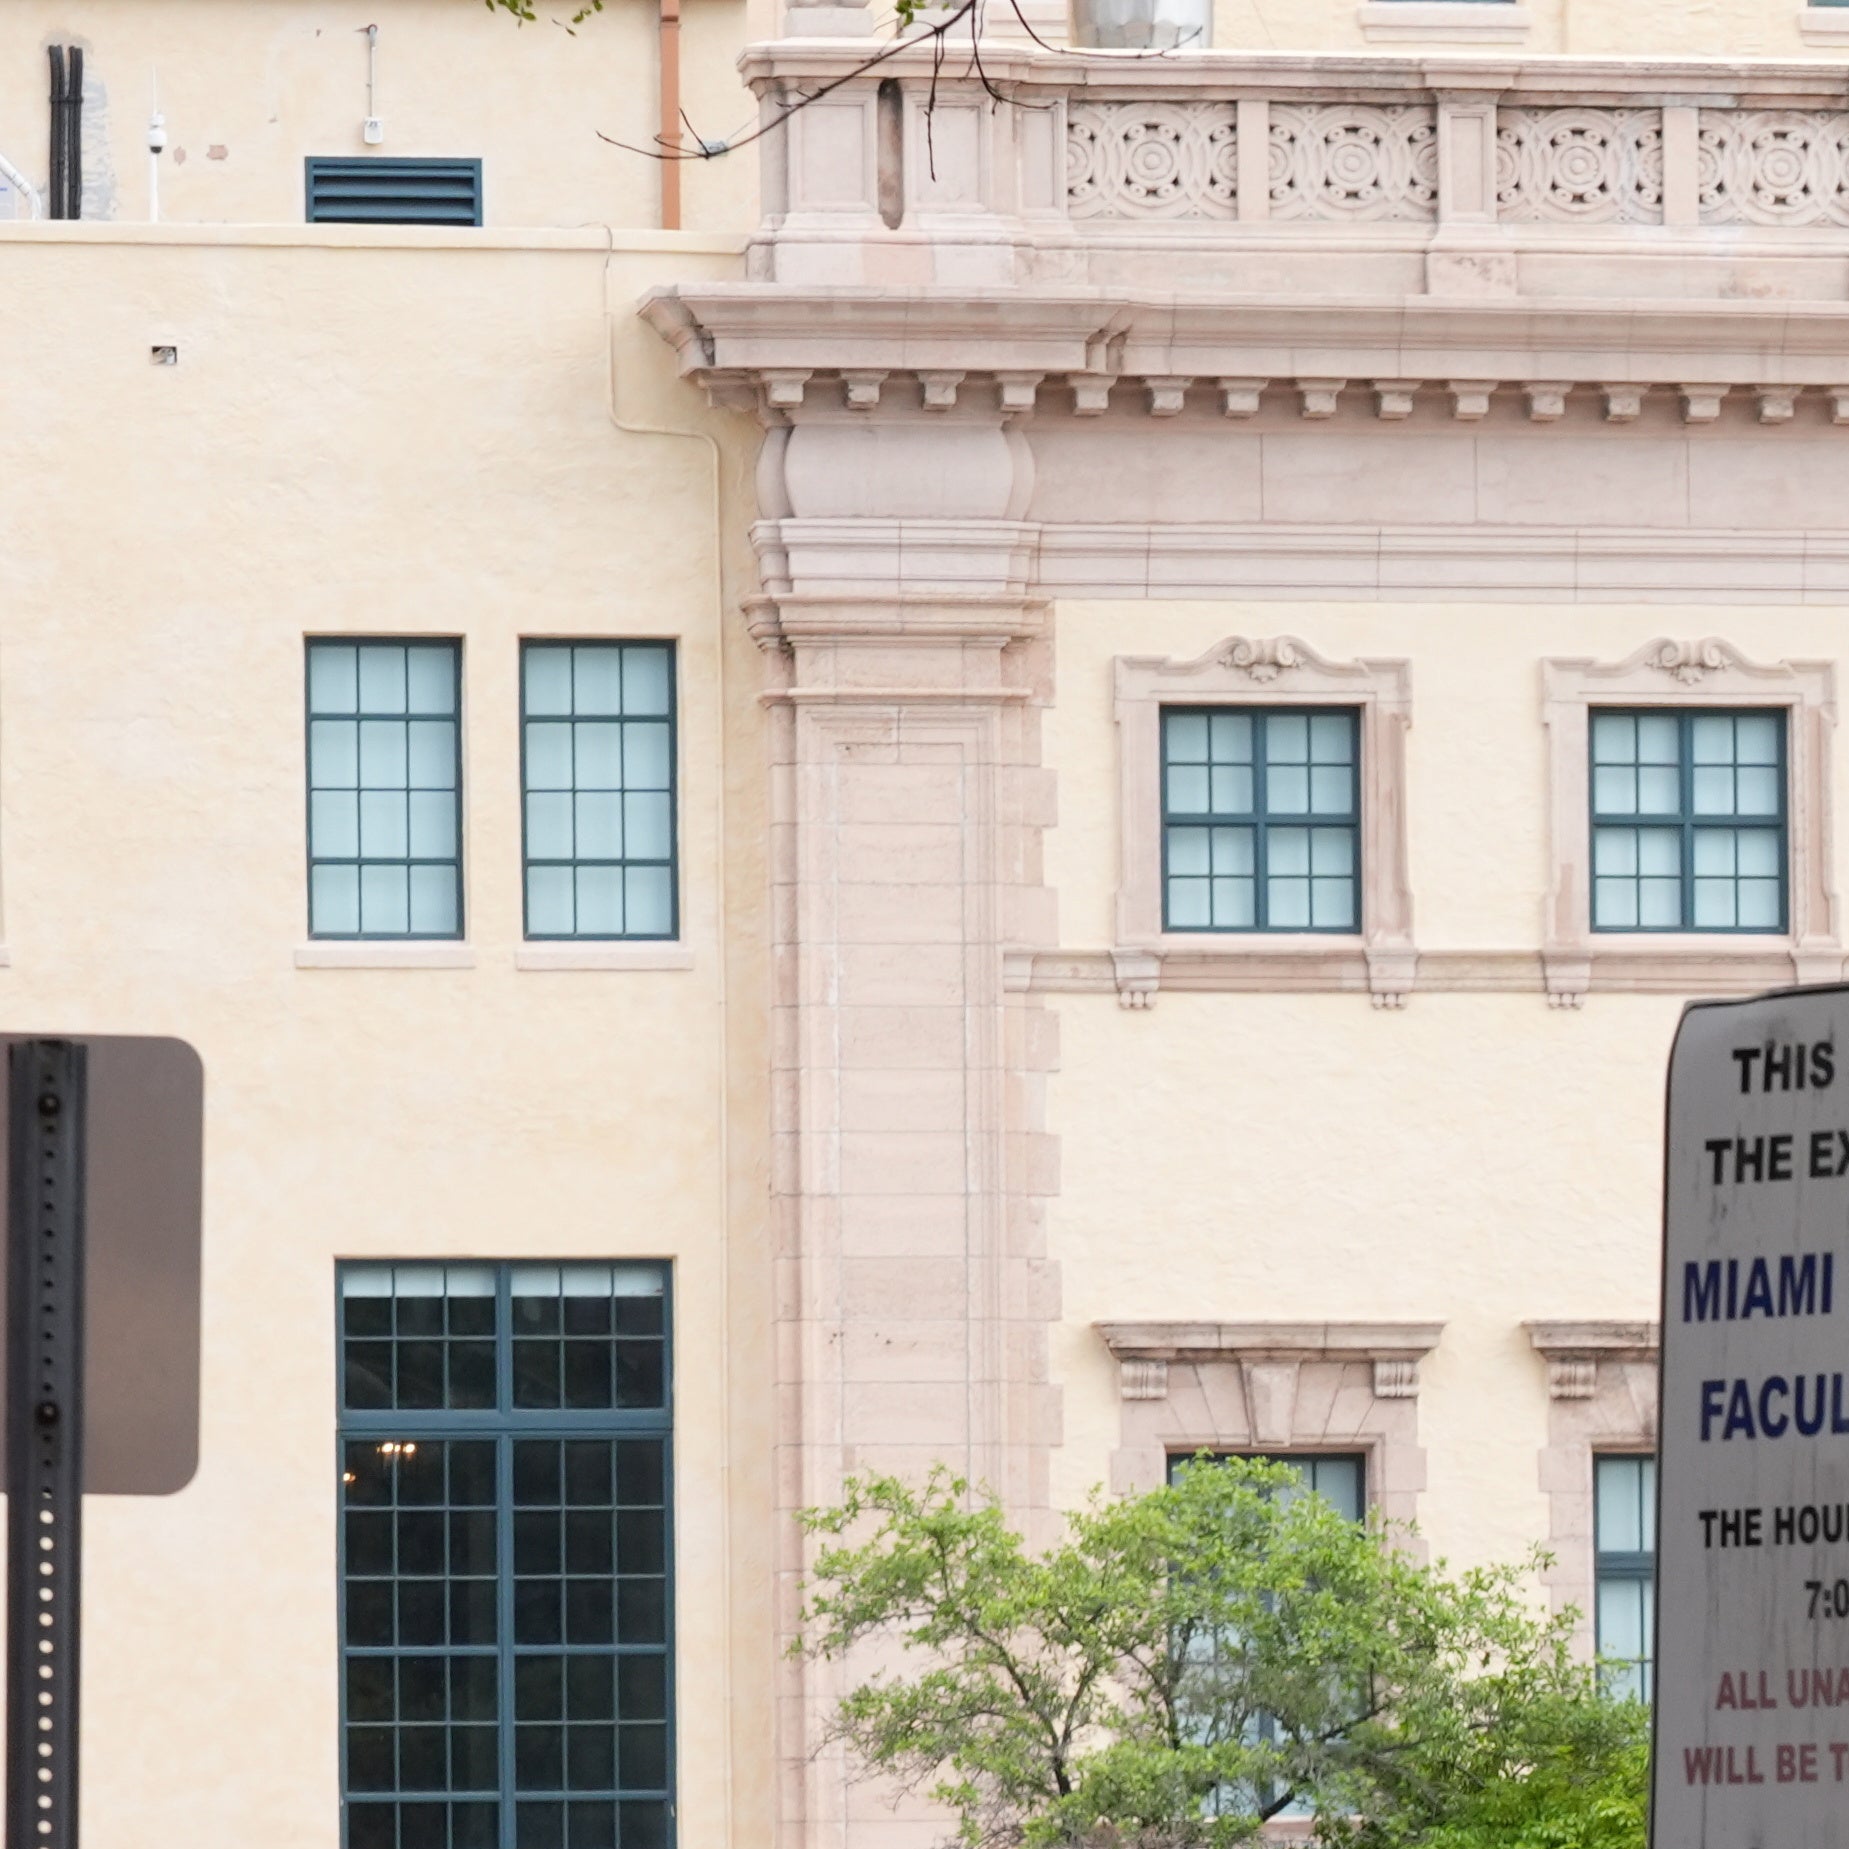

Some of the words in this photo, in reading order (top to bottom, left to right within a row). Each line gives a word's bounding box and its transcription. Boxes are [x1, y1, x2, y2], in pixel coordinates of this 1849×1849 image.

[1733, 1042, 1833, 1094] THIS
[1705, 1134, 1793, 1185] THE
[1683, 1252, 1833, 1323] MIAMI
[1700, 1507, 1762, 1549] THE
[1715, 1670, 1777, 1711] ALL
[1683, 1745, 1764, 1786] WILL
[1776, 1743, 1818, 1783] BE
